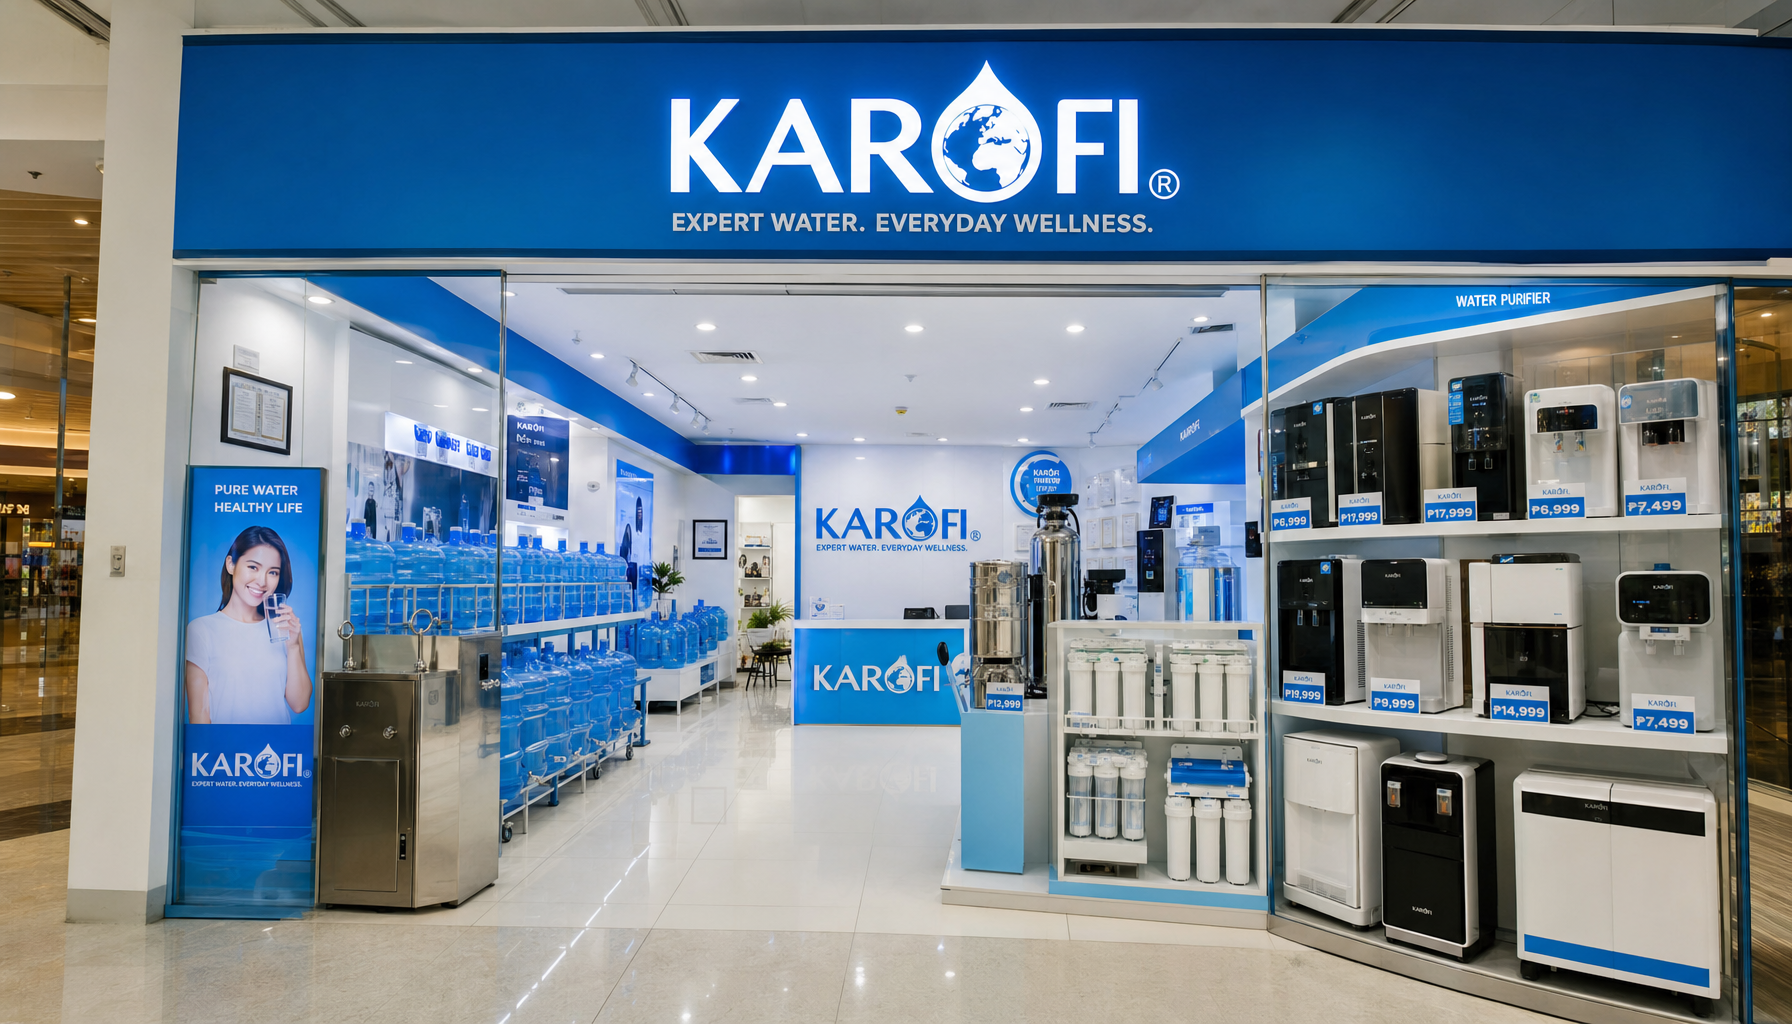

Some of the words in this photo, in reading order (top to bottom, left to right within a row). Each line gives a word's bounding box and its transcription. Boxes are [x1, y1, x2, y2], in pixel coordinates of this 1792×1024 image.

[672, 212, 765, 232] EXPERT
[770, 212, 866, 233] WATER.
[876, 212, 1007, 233] EVERYDAY
[1013, 213, 1154, 234] WELLNESS.
[1455, 294, 1497, 307] WATER
[1501, 292, 1551, 306] PURIFIER
[215, 484, 249, 496] PURE
[252, 484, 298, 496] WATER
[214, 502, 274, 513] HEALTHY
[276, 502, 303, 513] LIFE
[815, 543, 847, 552] EXPERT
[849, 543, 880, 552] WATER.
[881, 543, 924, 552] EVERYDAY
[925, 543, 968, 552] WELLNESS.
